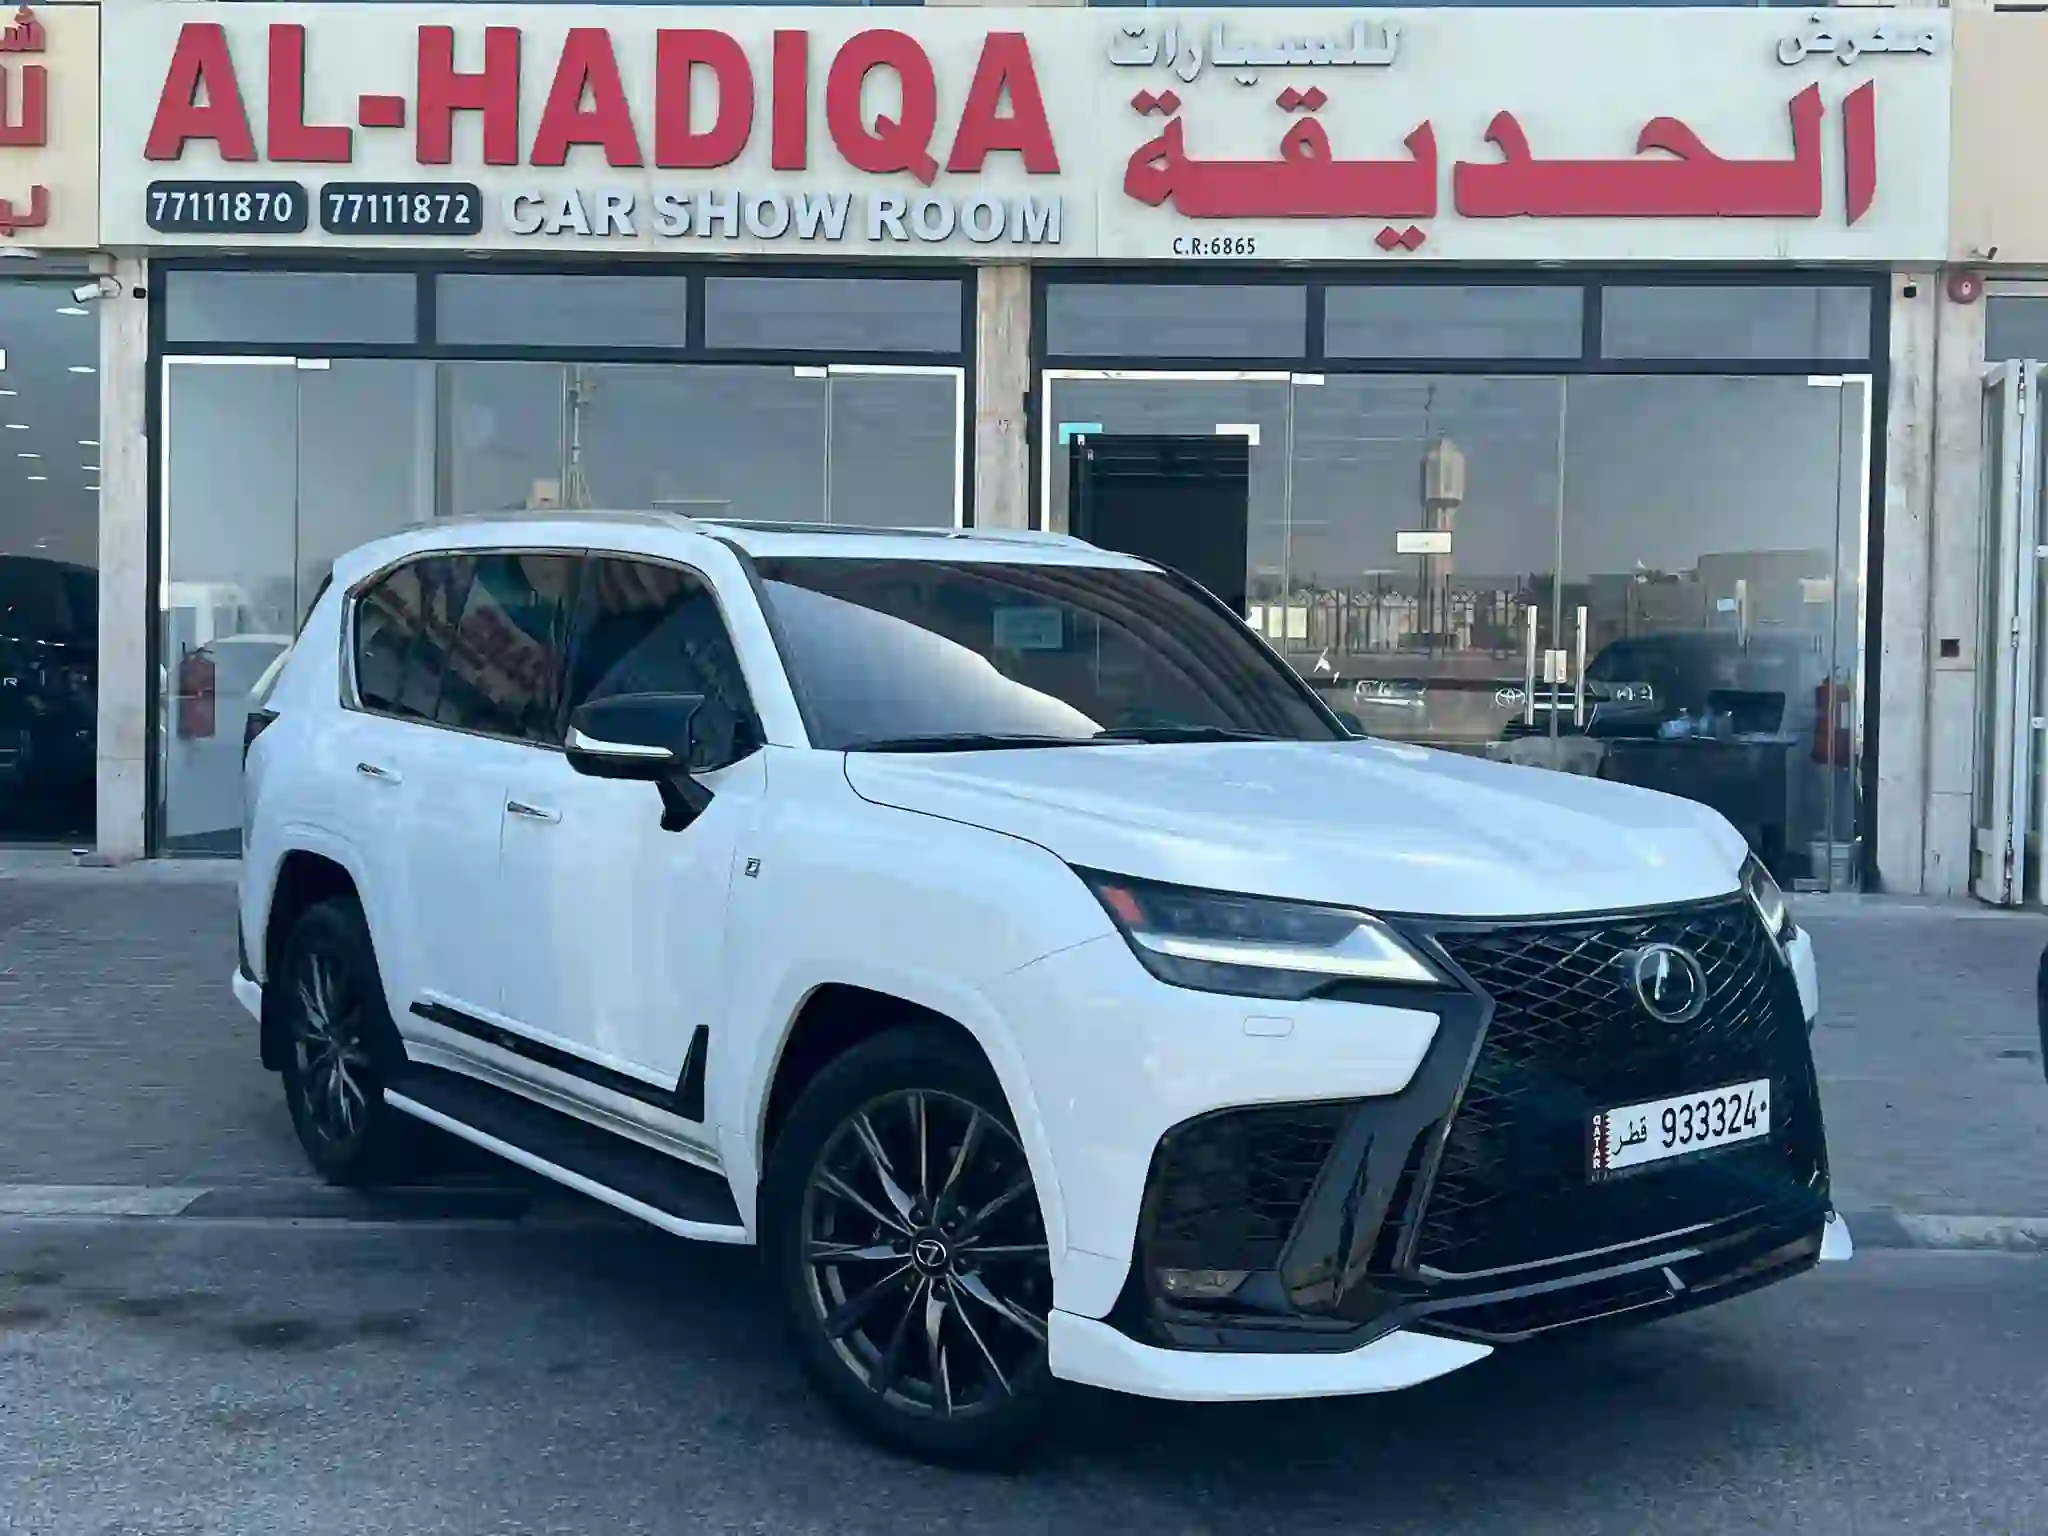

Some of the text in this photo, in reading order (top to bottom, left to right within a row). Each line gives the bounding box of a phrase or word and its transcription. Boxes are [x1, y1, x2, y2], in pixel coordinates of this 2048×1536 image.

[1108, 20, 1401, 86] للسيارات
[1777, 12, 1935, 67] معرض
[144, 22, 1061, 187] AL-HADIQA
[1123, 78, 1877, 252] الحديقة
[151, 190, 293, 223] 77111870
[327, 192, 472, 226] 77111872
[507, 190, 1063, 244] CAR SHOW ROOM
[1173, 237, 1256, 256] C.R:6865
[1592, 1114, 1601, 1169] QATAR
[1611, 1115, 1648, 1156] قطر
[1661, 1090, 1757, 1149] 933324
